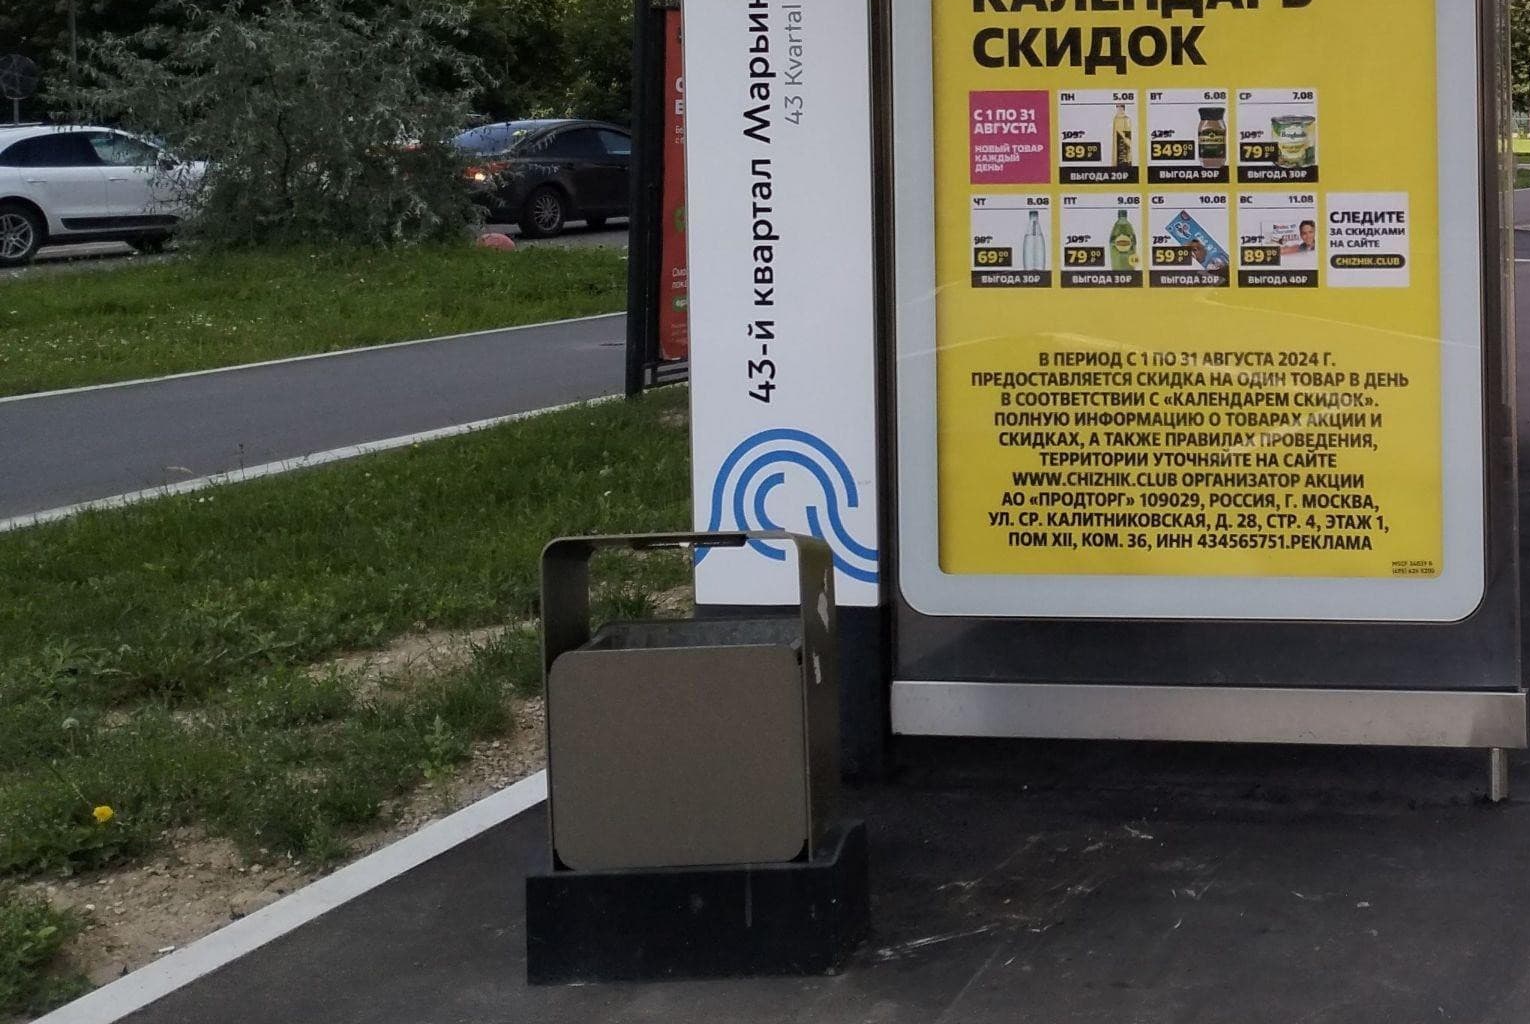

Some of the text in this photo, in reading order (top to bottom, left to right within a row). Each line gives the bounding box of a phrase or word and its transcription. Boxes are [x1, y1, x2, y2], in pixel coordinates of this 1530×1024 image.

[781, 5, 803, 86] Kvartal
[971, 25, 1208, 75] СКИДОК
[1060, 93, 1134, 101] ПН 5.08
[1150, 92, 1227, 101] ВТ 6.08
[1239, 92, 1313, 101] СР 7.08
[784, 95, 803, 125] 43
[974, 109, 1035, 120] С 1 ПО 31
[974, 123, 1037, 134] АВГУСТА
[975, 143, 1044, 153] НОВЫЙ ТОВАР
[975, 153, 1020, 163] КАЖДЫЙ
[975, 164, 1003, 172] ДЕНЬ!
[1070, 172, 1109, 181] ВЫГОДА
[1160, 170, 1199, 180] ВЫГОДА
[1248, 170, 1287, 180] ВЫГОДА
[973, 198, 1050, 206] ЧТ 8.08
[1064, 196, 1140, 205] ПТ 9.08
[1152, 196, 1227, 204] СБ 10.08
[1240, 196, 1314, 204] ВС 11.08
[1330, 211, 1405, 226] СЛЕДИТЕ
[751, 159, 780, 306] квартал
[1330, 228, 1406, 237] ЗА СКИДКАМИ
[1330, 238, 1380, 248] НА САЙТЕ
[981, 276, 1021, 285] ВЫГОДА
[1072, 275, 1113, 284] ВЫГОДА
[1160, 276, 1200, 285] ВЫГОДА
[1248, 276, 1287, 285] ВЫГОДА
[747, 321, 776, 403] 43-й
[1039, 352, 1336, 368] В ПЕРИОД С 1 ПО 31 АВГУСТА 2024 Г.
[971, 372, 1409, 390] ПРЕДОСТАВЛЯЕТСЯ СКИДКА НА ОДИН ТОВАР В ДЕНЬ
[1001, 392, 1379, 409] В СООТВЕТСТВИИ С «КАЛЕНДАРЕМ СКИДОК».
[994, 412, 1382, 430] ПОЛНУЮ ИНФОРМАЦИЮ О ТОВАРАХ АКЦИИ И
[999, 432, 1378, 451] СКИДКАХ, А ТАКЖЕ ПРАВИЛАХ ПРОВЕДЕНИЯ,
[1040, 450, 1337, 468] ТЕРРИТОРИИ УТОЧНЯЙТЕ НА САЙТЕ
[1012, 472, 1365, 491] WWW.CHIZHIK.CLUB ОРГАНИЗАТОР АКЦИИ
[1002, 492, 1379, 512] АО «ПРОДТОРГ» 109029, РОССИЯ, Г. МОСКВА,
[988, 512, 1389, 533] УЛ. СР. КАЛИТНИКОВСКАЯ, Д. 28, СТР. 4, ЭТАЖ 1,
[1008, 532, 1047, 547] ПОМ
[1082, 533, 1123, 548] КОМ.
[1127, 534, 1152, 551] 36,
[1157, 534, 1193, 548] ИНН
